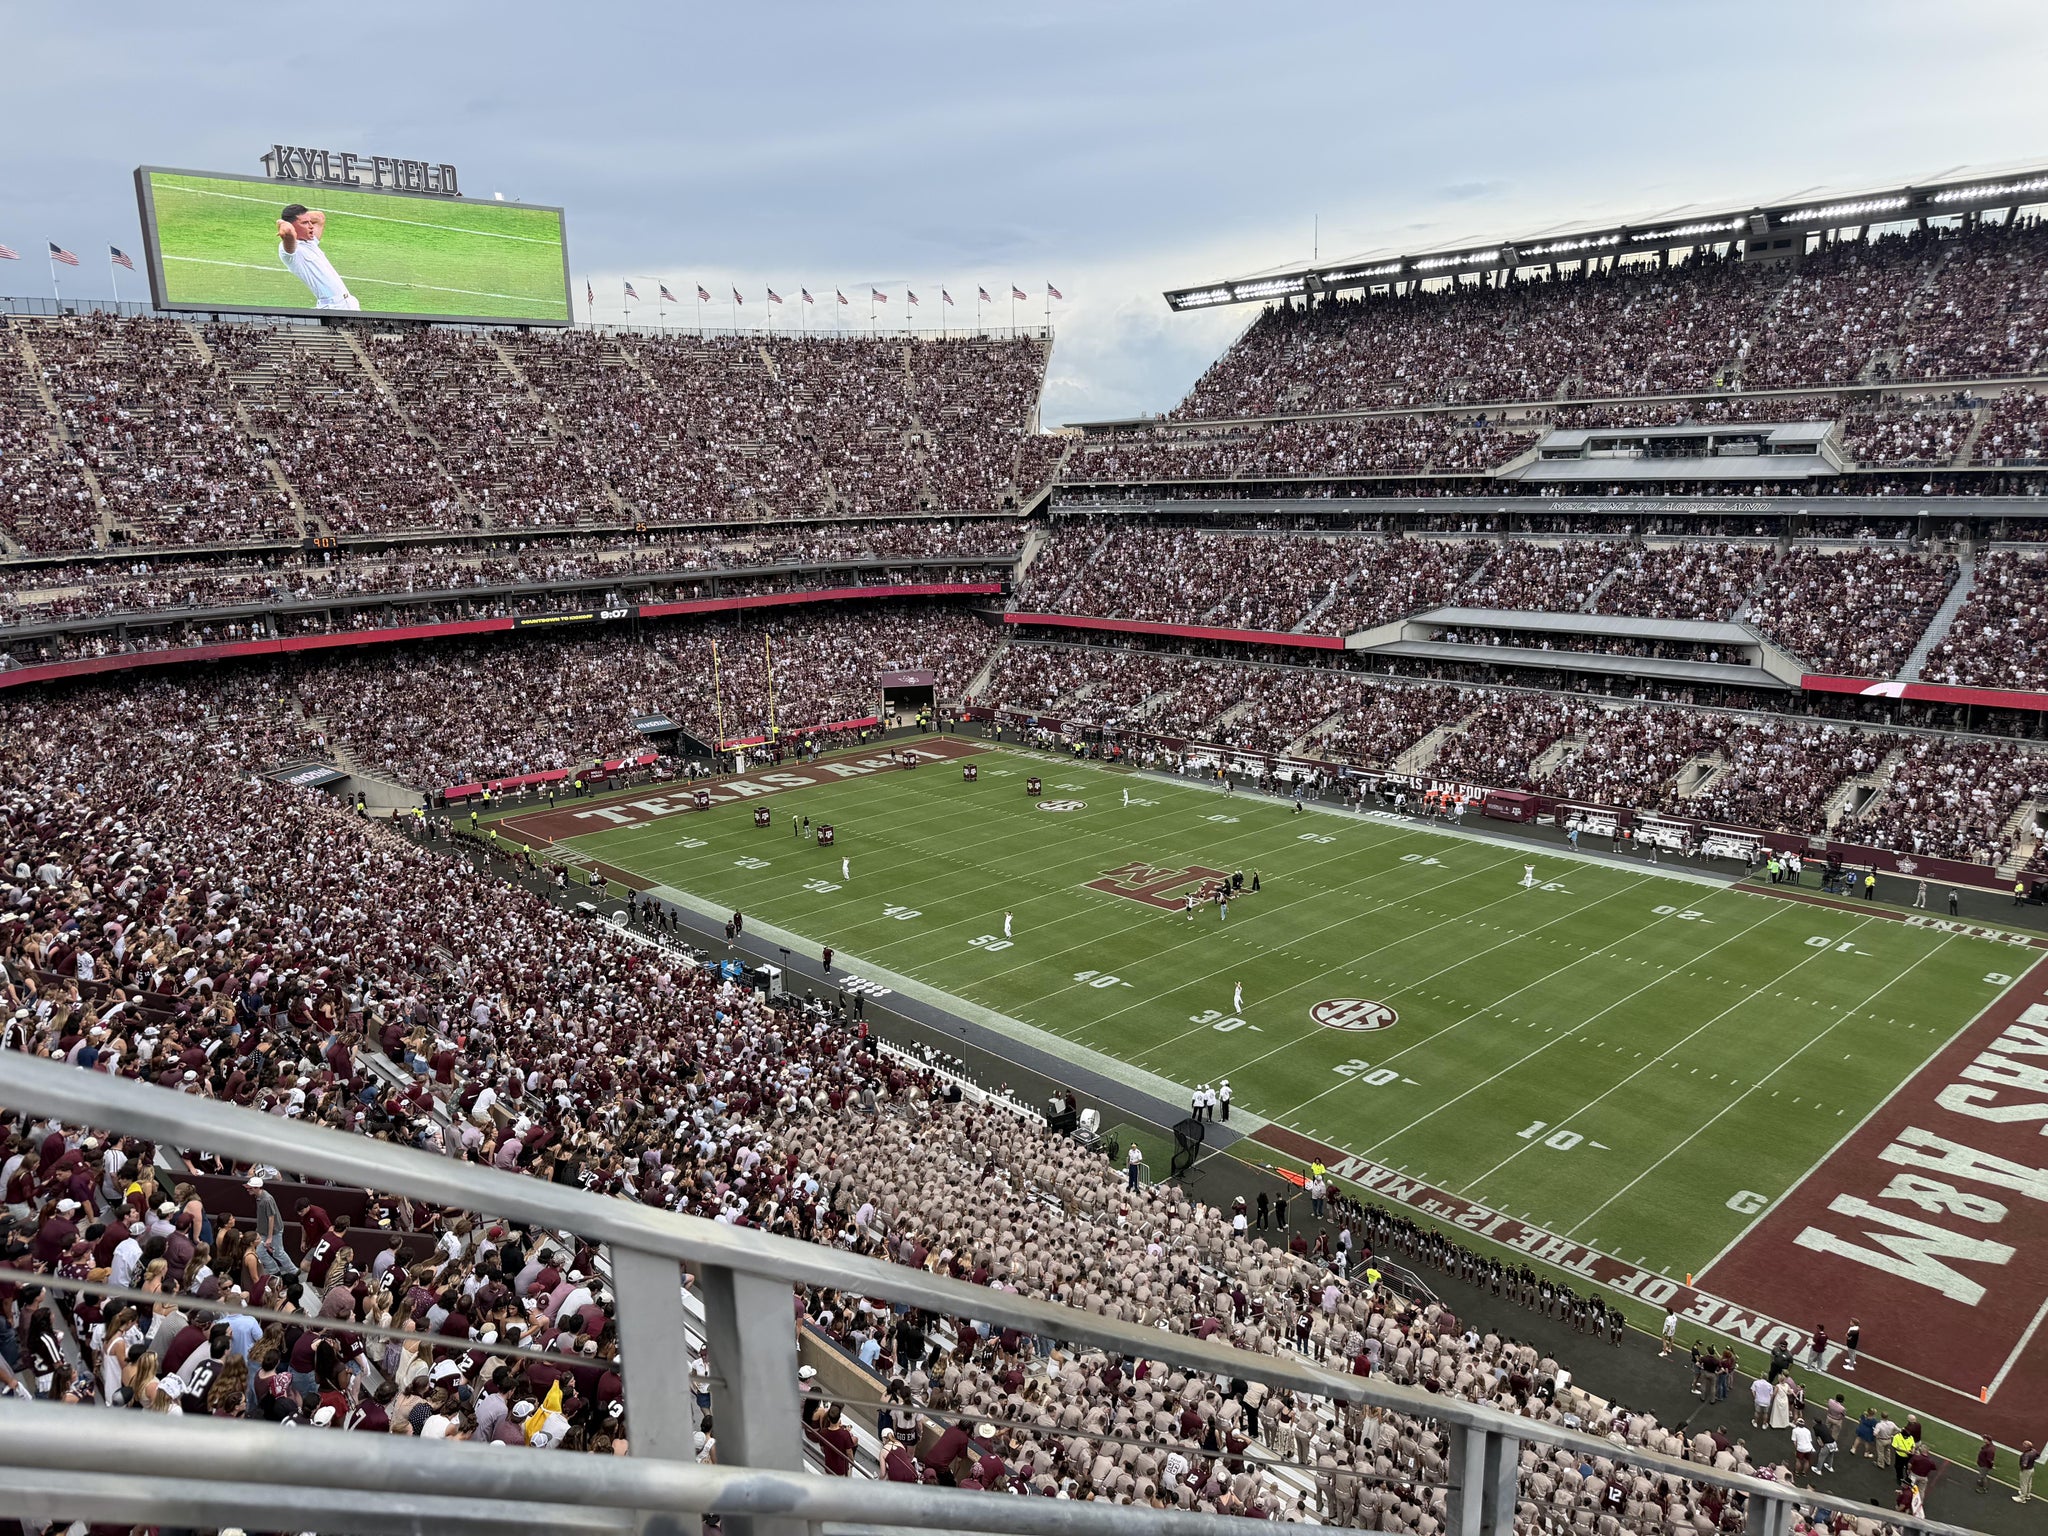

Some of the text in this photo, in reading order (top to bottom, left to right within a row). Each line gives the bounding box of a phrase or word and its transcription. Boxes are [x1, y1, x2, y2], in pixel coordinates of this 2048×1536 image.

[272, 144, 459, 196] KYLE FIELD
[1549, 502, 1772, 512] WELCOME TO AGGIELAND
[521, 616, 561, 625] COUNTDOWN
[600, 609, 628, 619] 9:07
[573, 748, 946, 824] TEXAS A&M
[1297, 832, 1337, 844] 50
[733, 857, 772, 870] 20
[803, 879, 843, 894] 30
[882, 905, 923, 921] 40
[1651, 905, 1705, 921] 20
[968, 934, 1015, 952] 50
[1804, 936, 1856, 953] 10
[1073, 970, 1121, 989] 40
[1982, 972, 2013, 985] G
[1189, 1009, 1247, 1033] 30
[1316, 1000, 1393, 1030] SEC
[1332, 1059, 1400, 1086] 20
[1515, 1120, 1584, 1151] 10
[1725, 1190, 1769, 1214] G
[1792, 1125, 2048, 1306] A&M
[314, 1239, 331, 1262] 12
[1327, 1156, 1844, 1371] HOME OF THE 12TH MAN
[380, 1269, 395, 1292] 12
[1298, 1314, 1309, 1328] 12
[190, 1366, 214, 1398] 12
[1187, 1473, 1199, 1485] 12
[1609, 1486, 1622, 1503] 12
